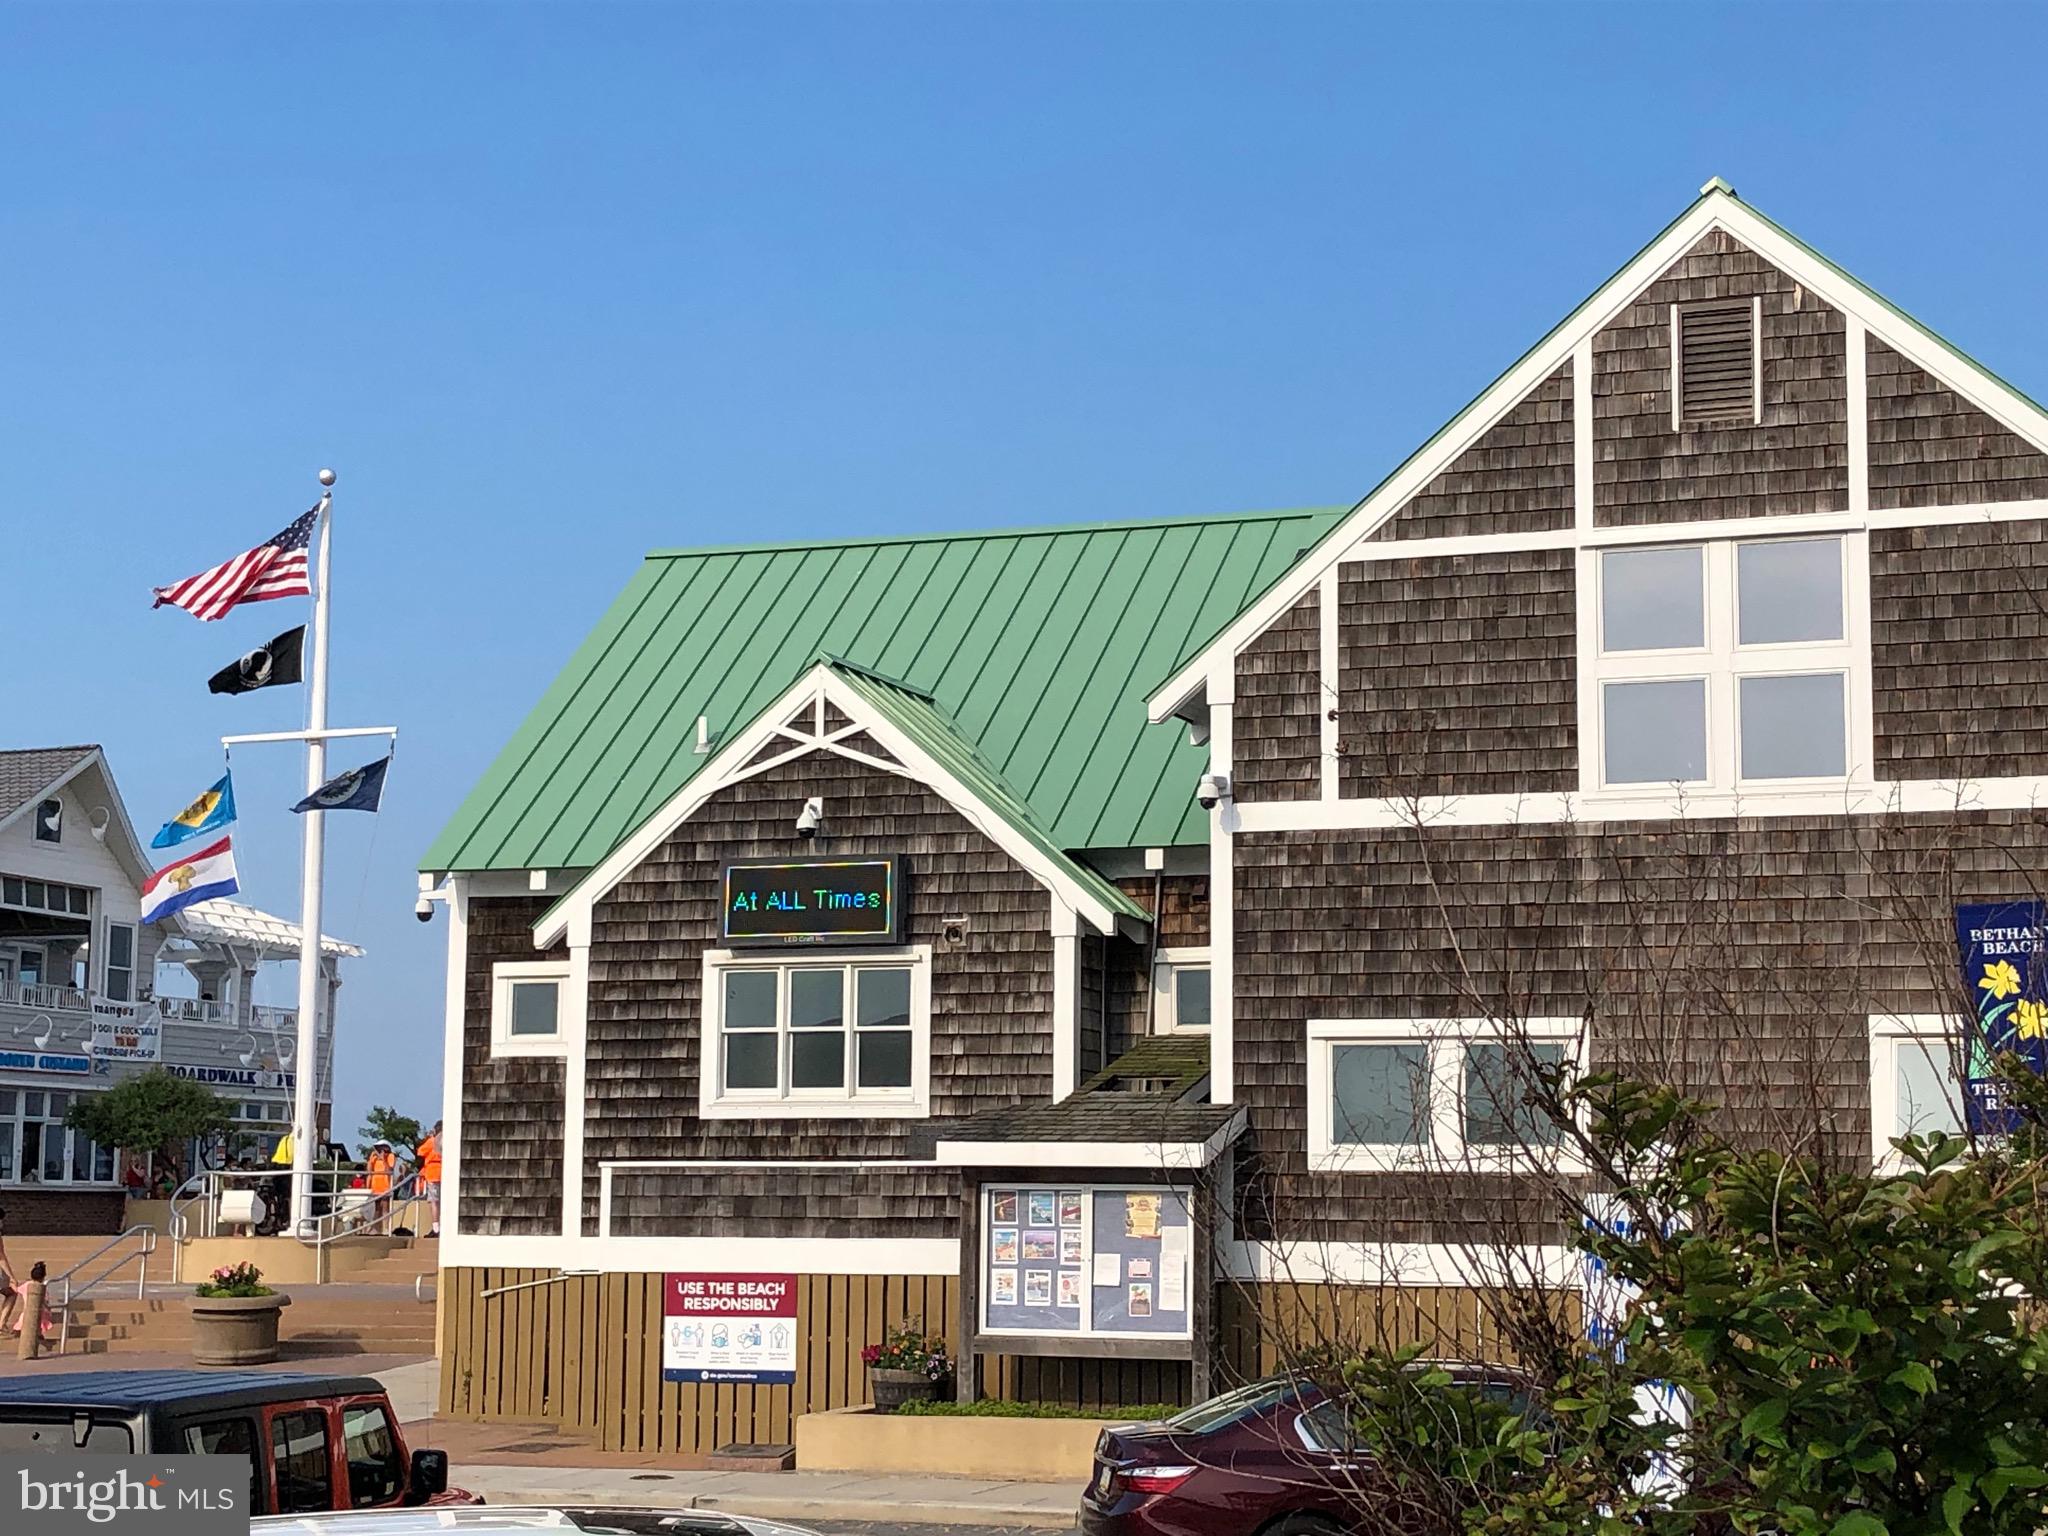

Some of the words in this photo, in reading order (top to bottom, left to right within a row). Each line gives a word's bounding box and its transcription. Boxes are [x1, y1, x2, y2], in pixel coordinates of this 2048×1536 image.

[733, 891, 758, 911] At
[766, 891, 807, 911] ALL
[813, 889, 881, 909] Times
[678, 1282, 706, 1295] USE
[708, 1282, 735, 1295] THE
[737, 1282, 786, 1296] BEACH
[684, 1297, 779, 1311] RESPONSIBLY
